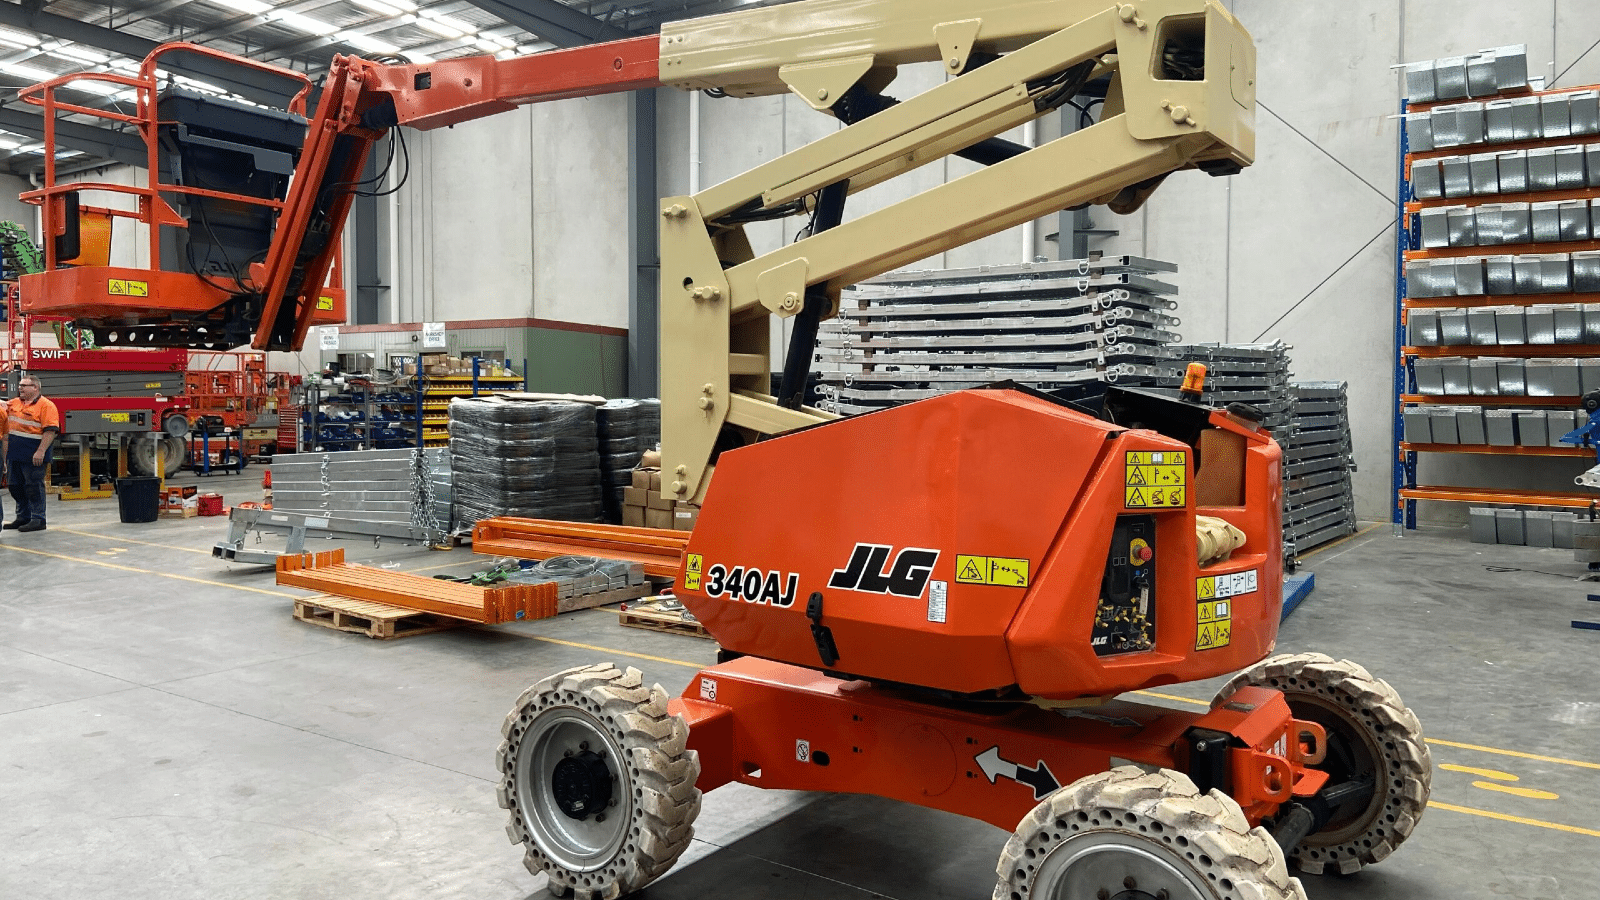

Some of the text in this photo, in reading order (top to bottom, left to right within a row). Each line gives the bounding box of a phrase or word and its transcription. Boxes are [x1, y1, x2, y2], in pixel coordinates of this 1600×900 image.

[32, 350, 71, 359] SWIFT
[826, 542, 941, 599] JLG
[705, 563, 799, 608] 340AJ
[1091, 636, 1108, 645] JLG
